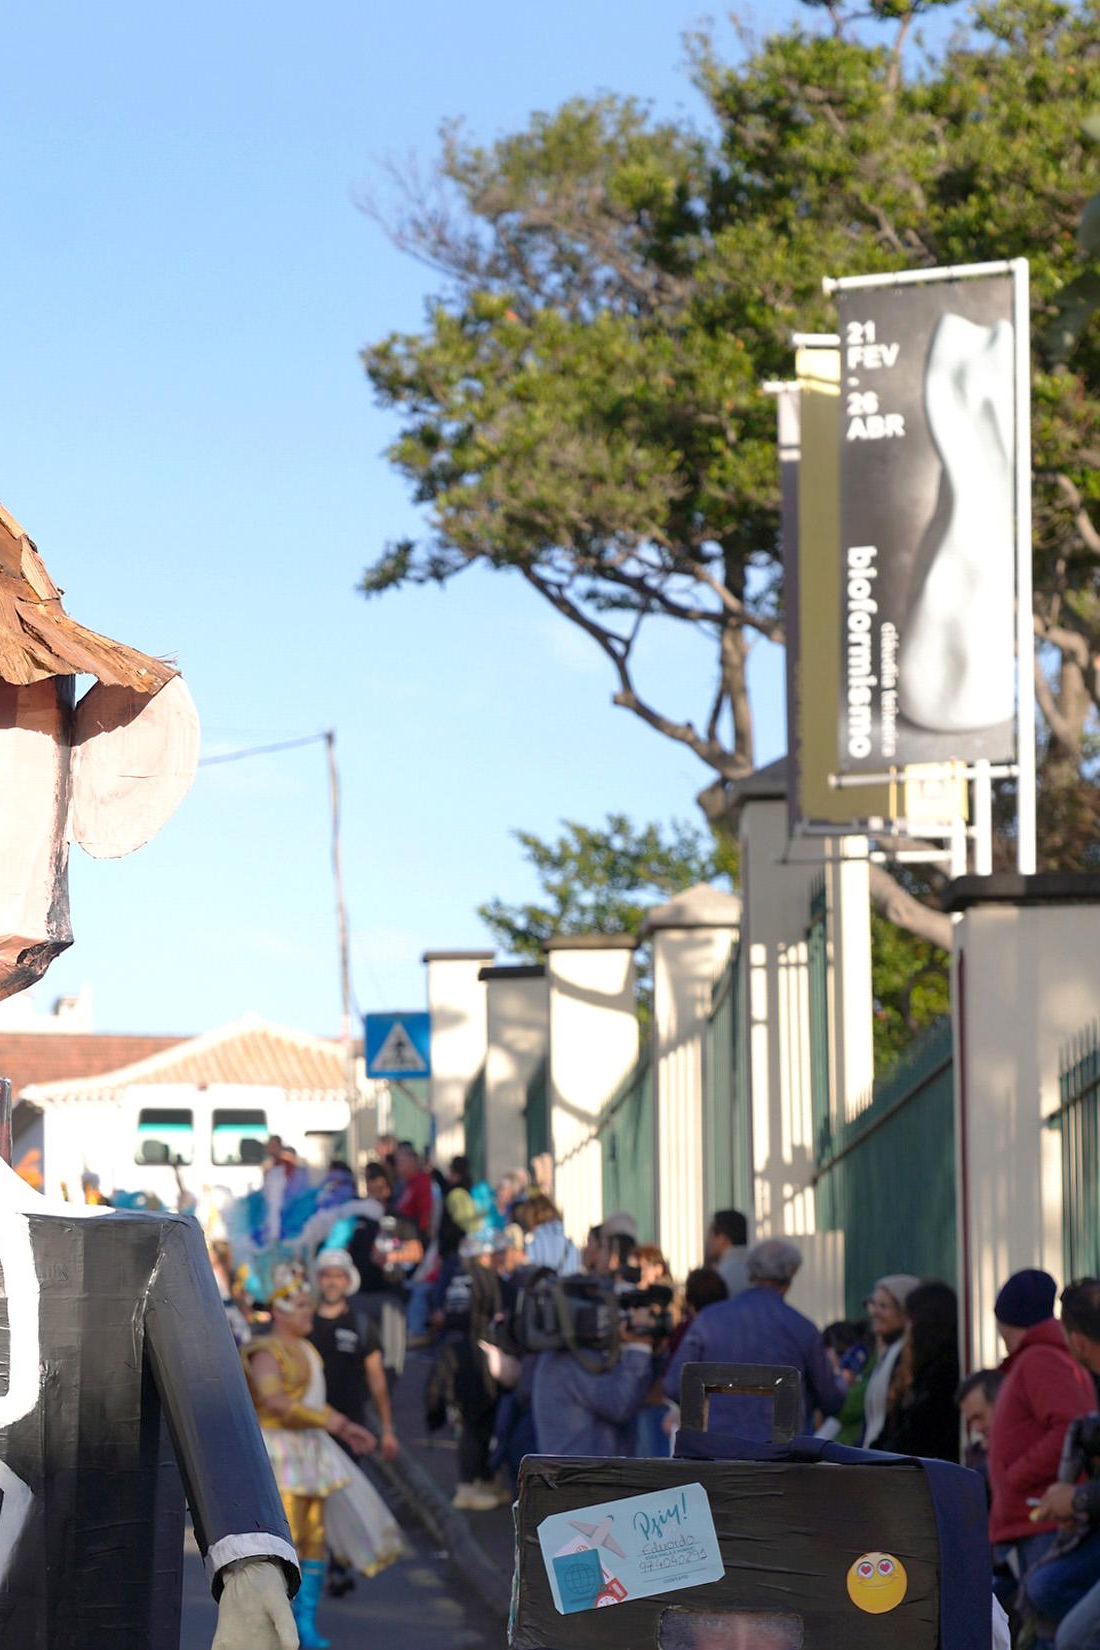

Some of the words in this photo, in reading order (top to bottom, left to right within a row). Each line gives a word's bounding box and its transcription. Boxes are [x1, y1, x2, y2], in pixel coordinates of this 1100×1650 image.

[846, 319, 876, 346] 21
[846, 342, 900, 370] FEV
[846, 413, 906, 441] ABR
[847, 545, 878, 759] bioformismo
